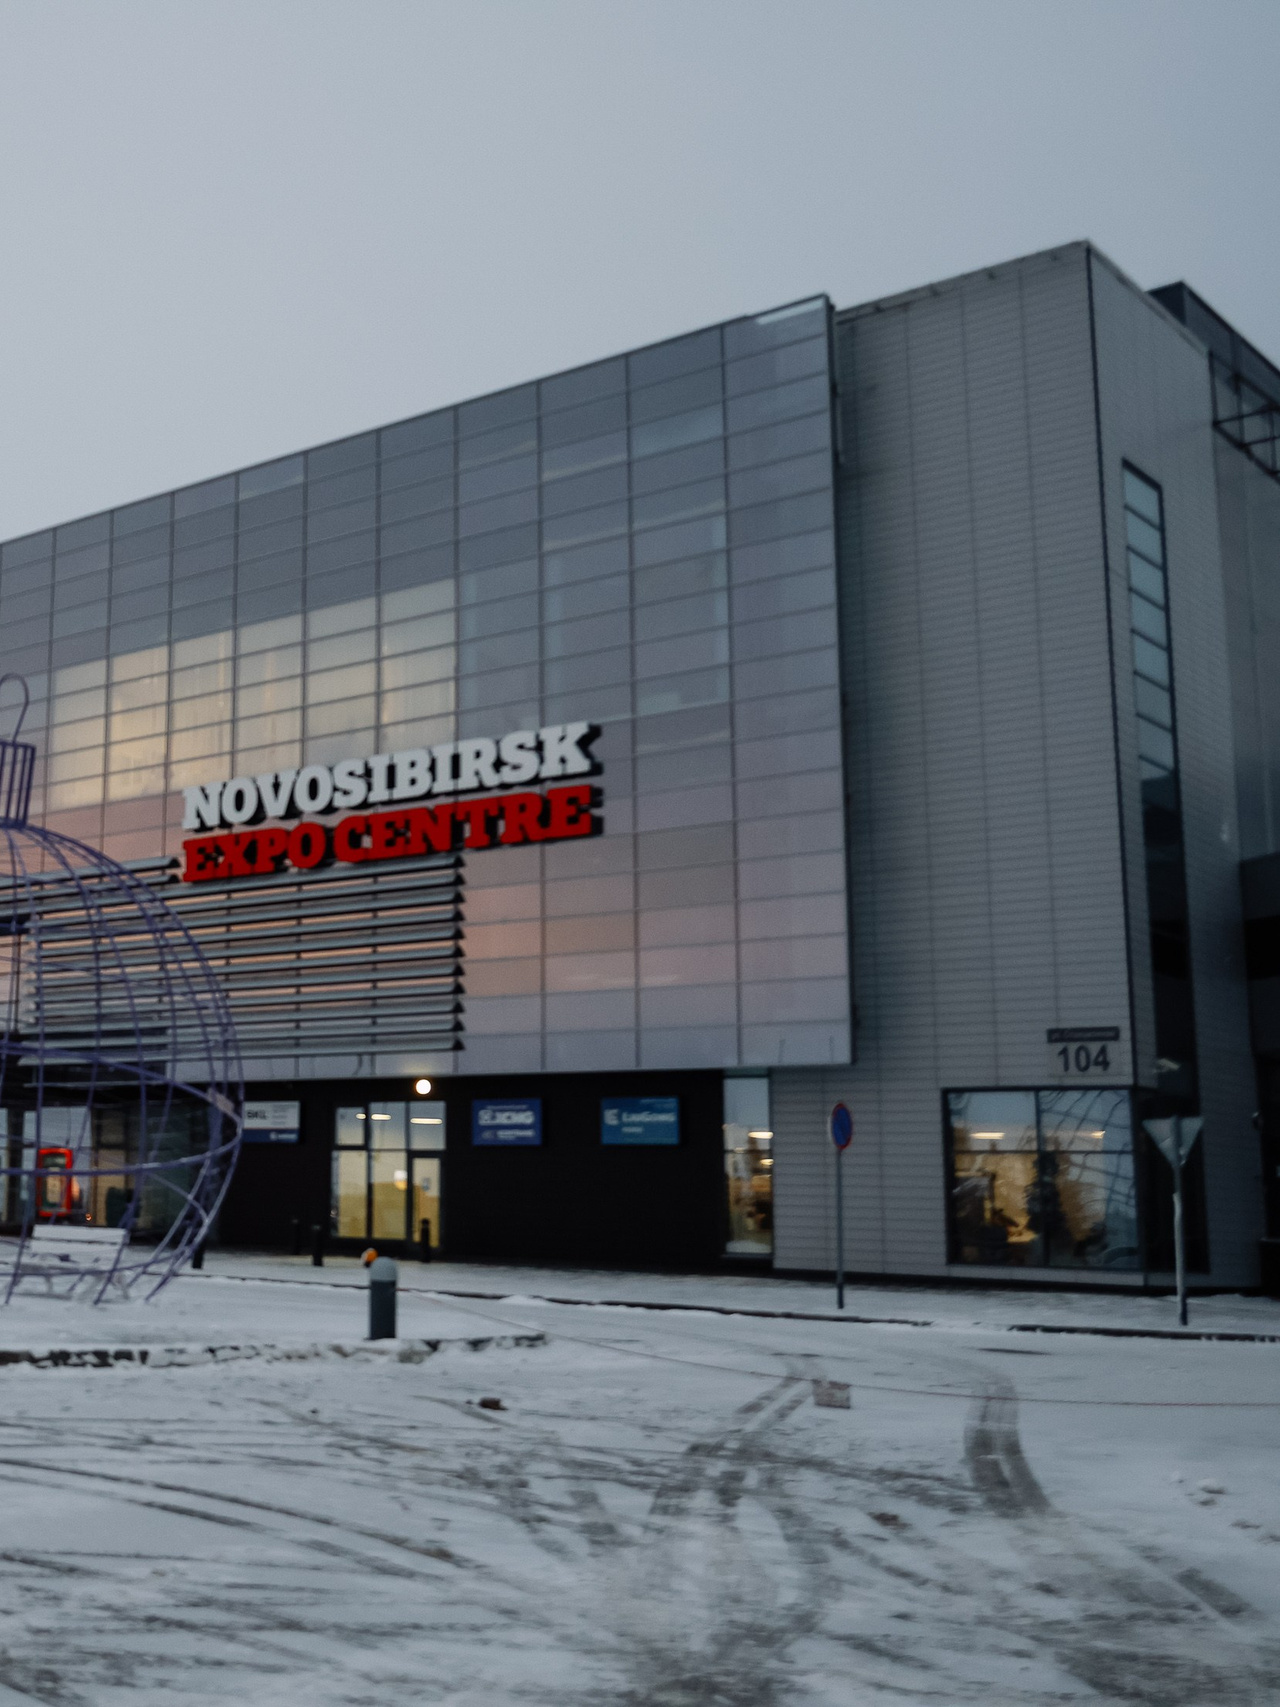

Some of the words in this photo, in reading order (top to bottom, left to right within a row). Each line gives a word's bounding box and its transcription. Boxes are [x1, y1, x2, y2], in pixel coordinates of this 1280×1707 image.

[182, 722, 593, 831] NOVOSIBIRSK
[182, 823, 326, 883] EXPO
[333, 785, 593, 864] CENTRE
[1058, 1044, 1110, 1073] 104
